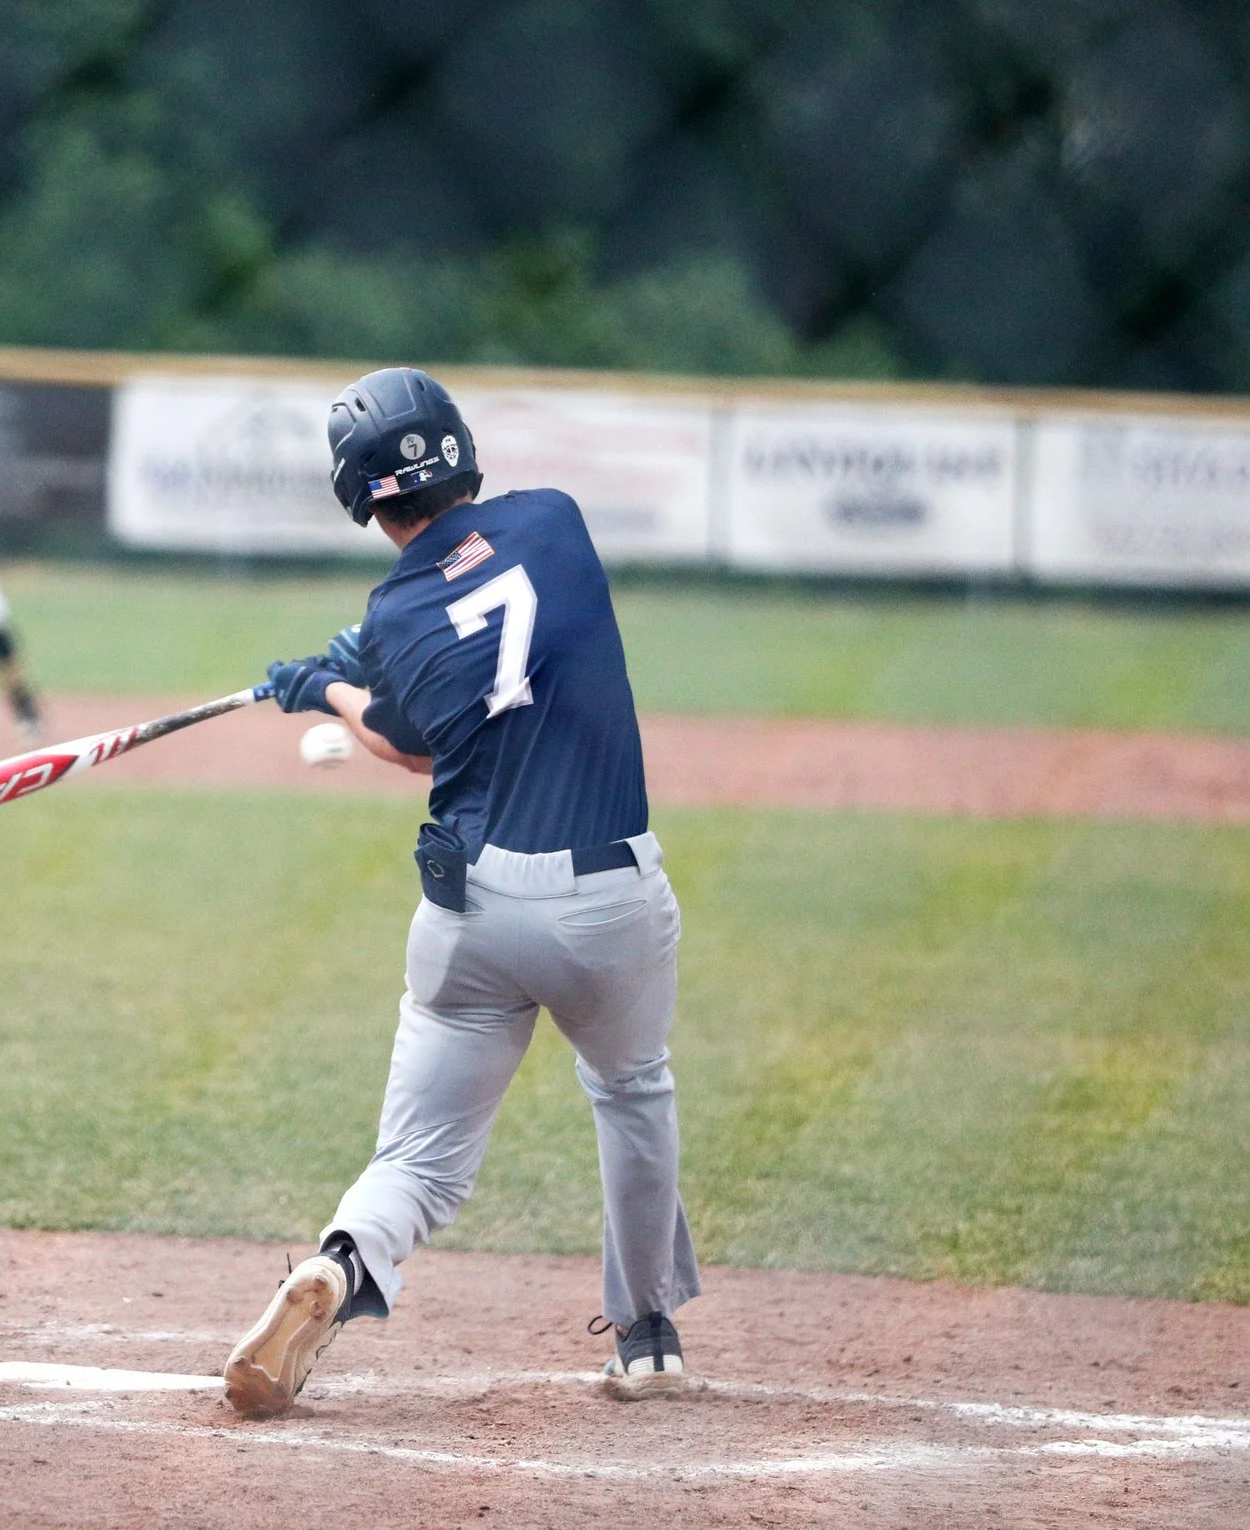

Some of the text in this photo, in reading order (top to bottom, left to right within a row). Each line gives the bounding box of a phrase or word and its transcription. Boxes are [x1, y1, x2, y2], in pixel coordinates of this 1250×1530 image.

[408, 443, 417, 457] 7
[394, 456, 440, 476] RAWLINGS
[445, 564, 538, 719] 7
